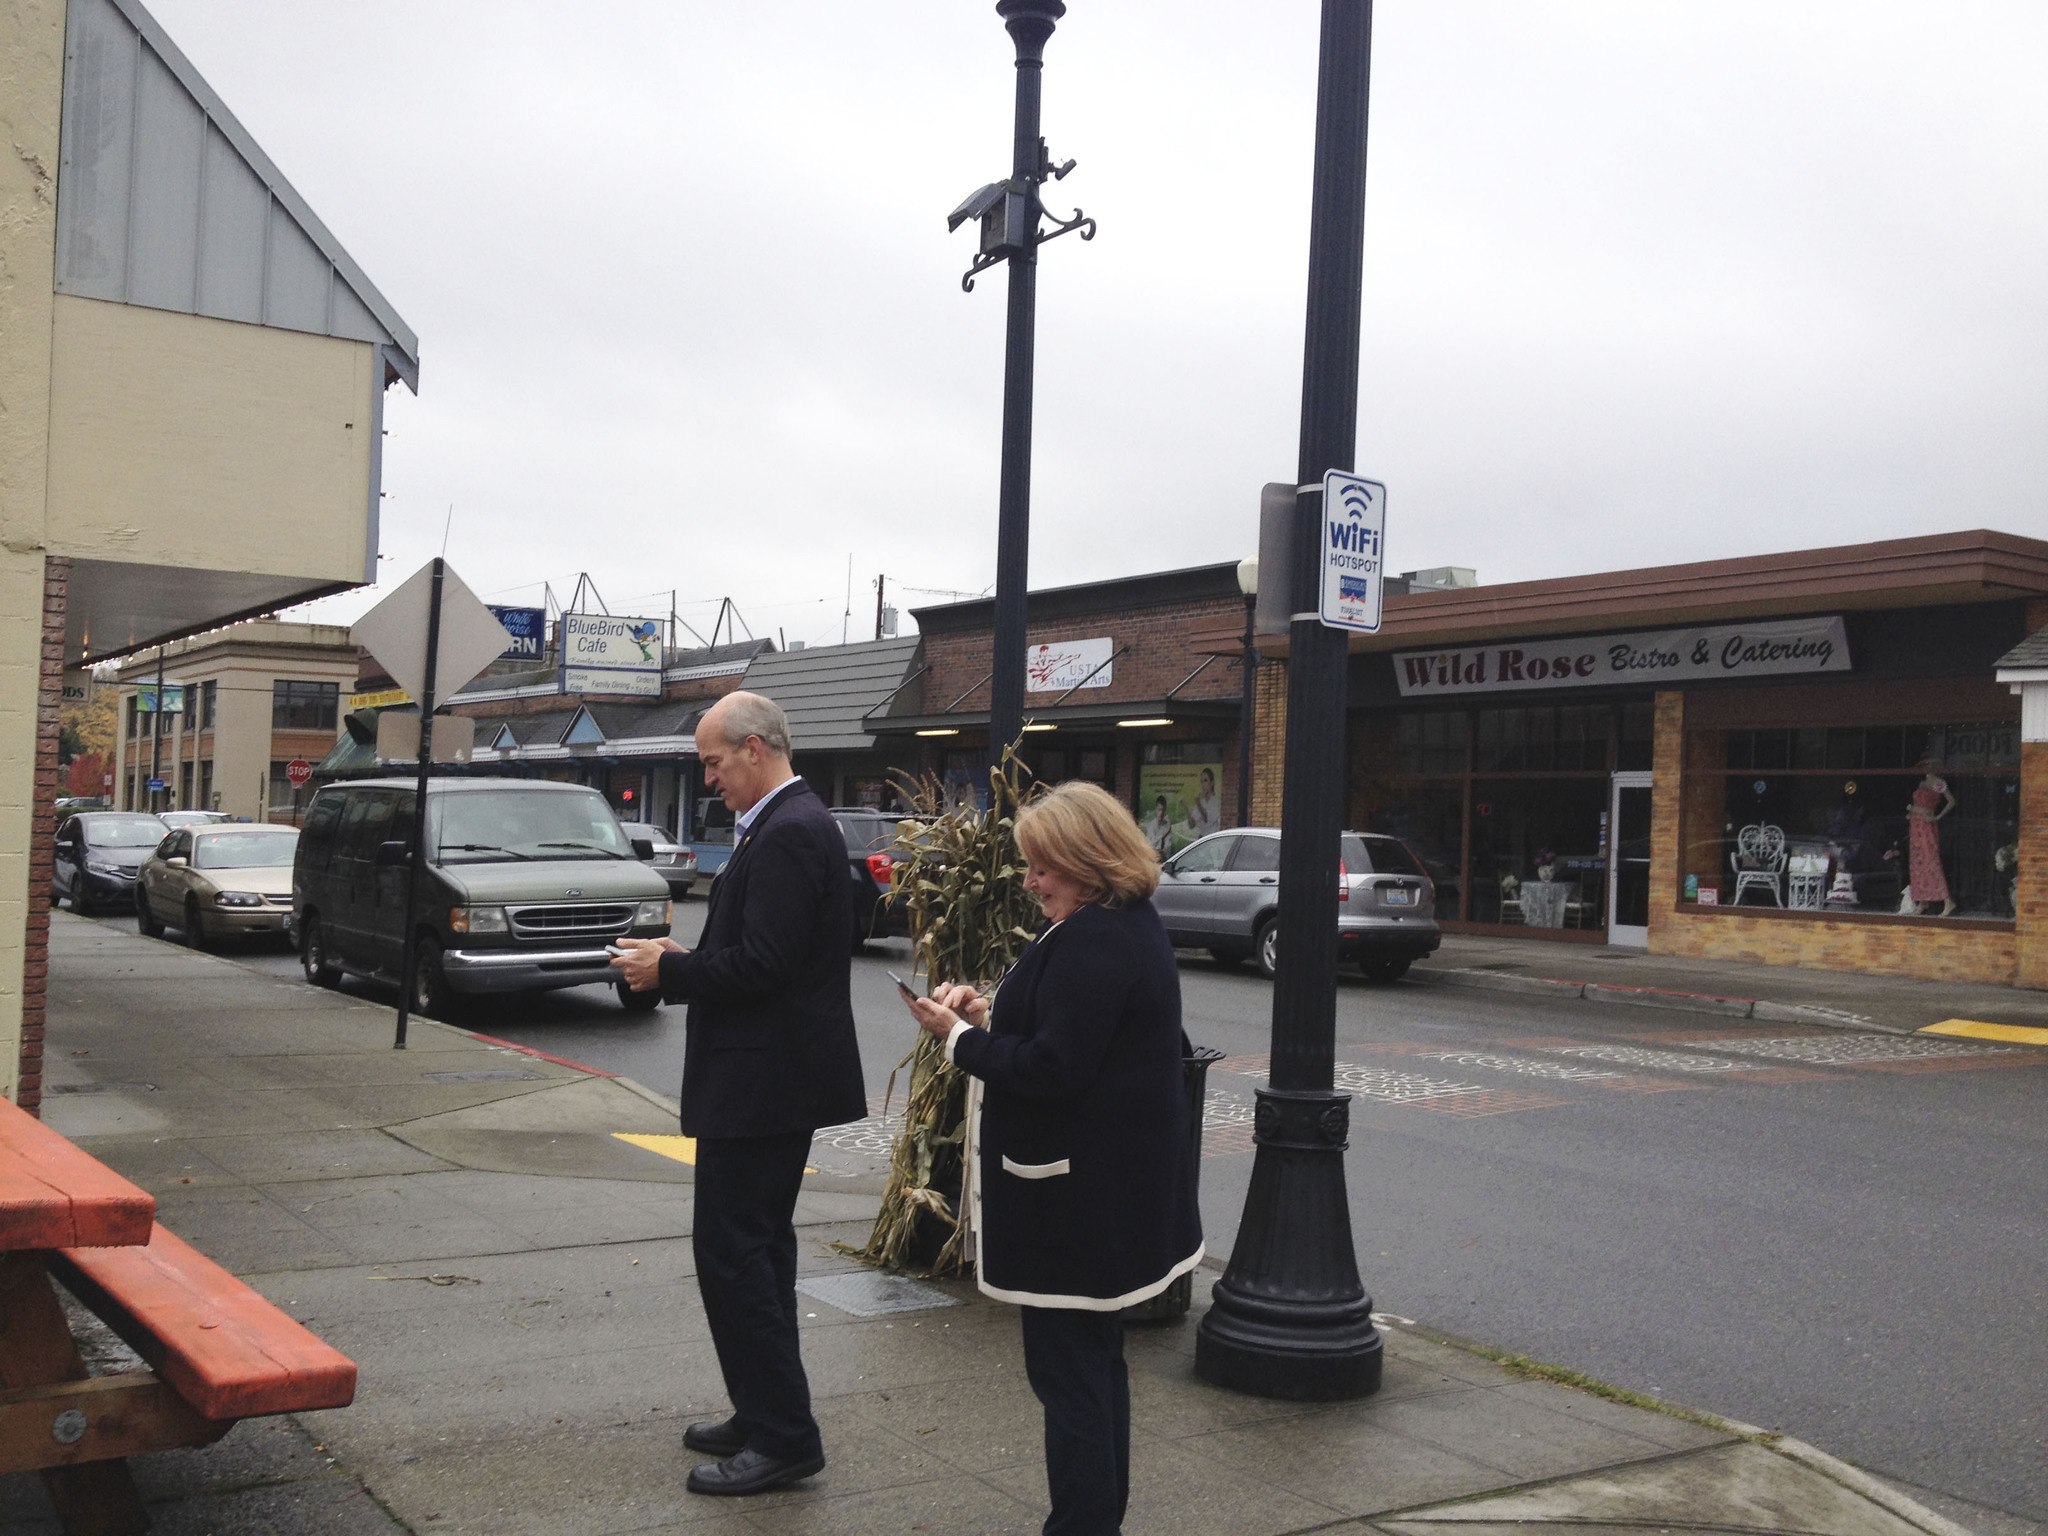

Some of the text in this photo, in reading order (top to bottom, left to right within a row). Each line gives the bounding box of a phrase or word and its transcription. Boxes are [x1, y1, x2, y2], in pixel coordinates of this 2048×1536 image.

[1329, 521, 1378, 556] WiFi
[1330, 552, 1378, 573] HOTSPOT
[568, 619, 624, 637] BlueBird
[578, 637, 607, 653] Cafe
[1403, 635, 1833, 688] Wild Rose Bistro & Catering
[1090, 675, 1111, 685] Arts
[288, 766, 310, 776] STOP
